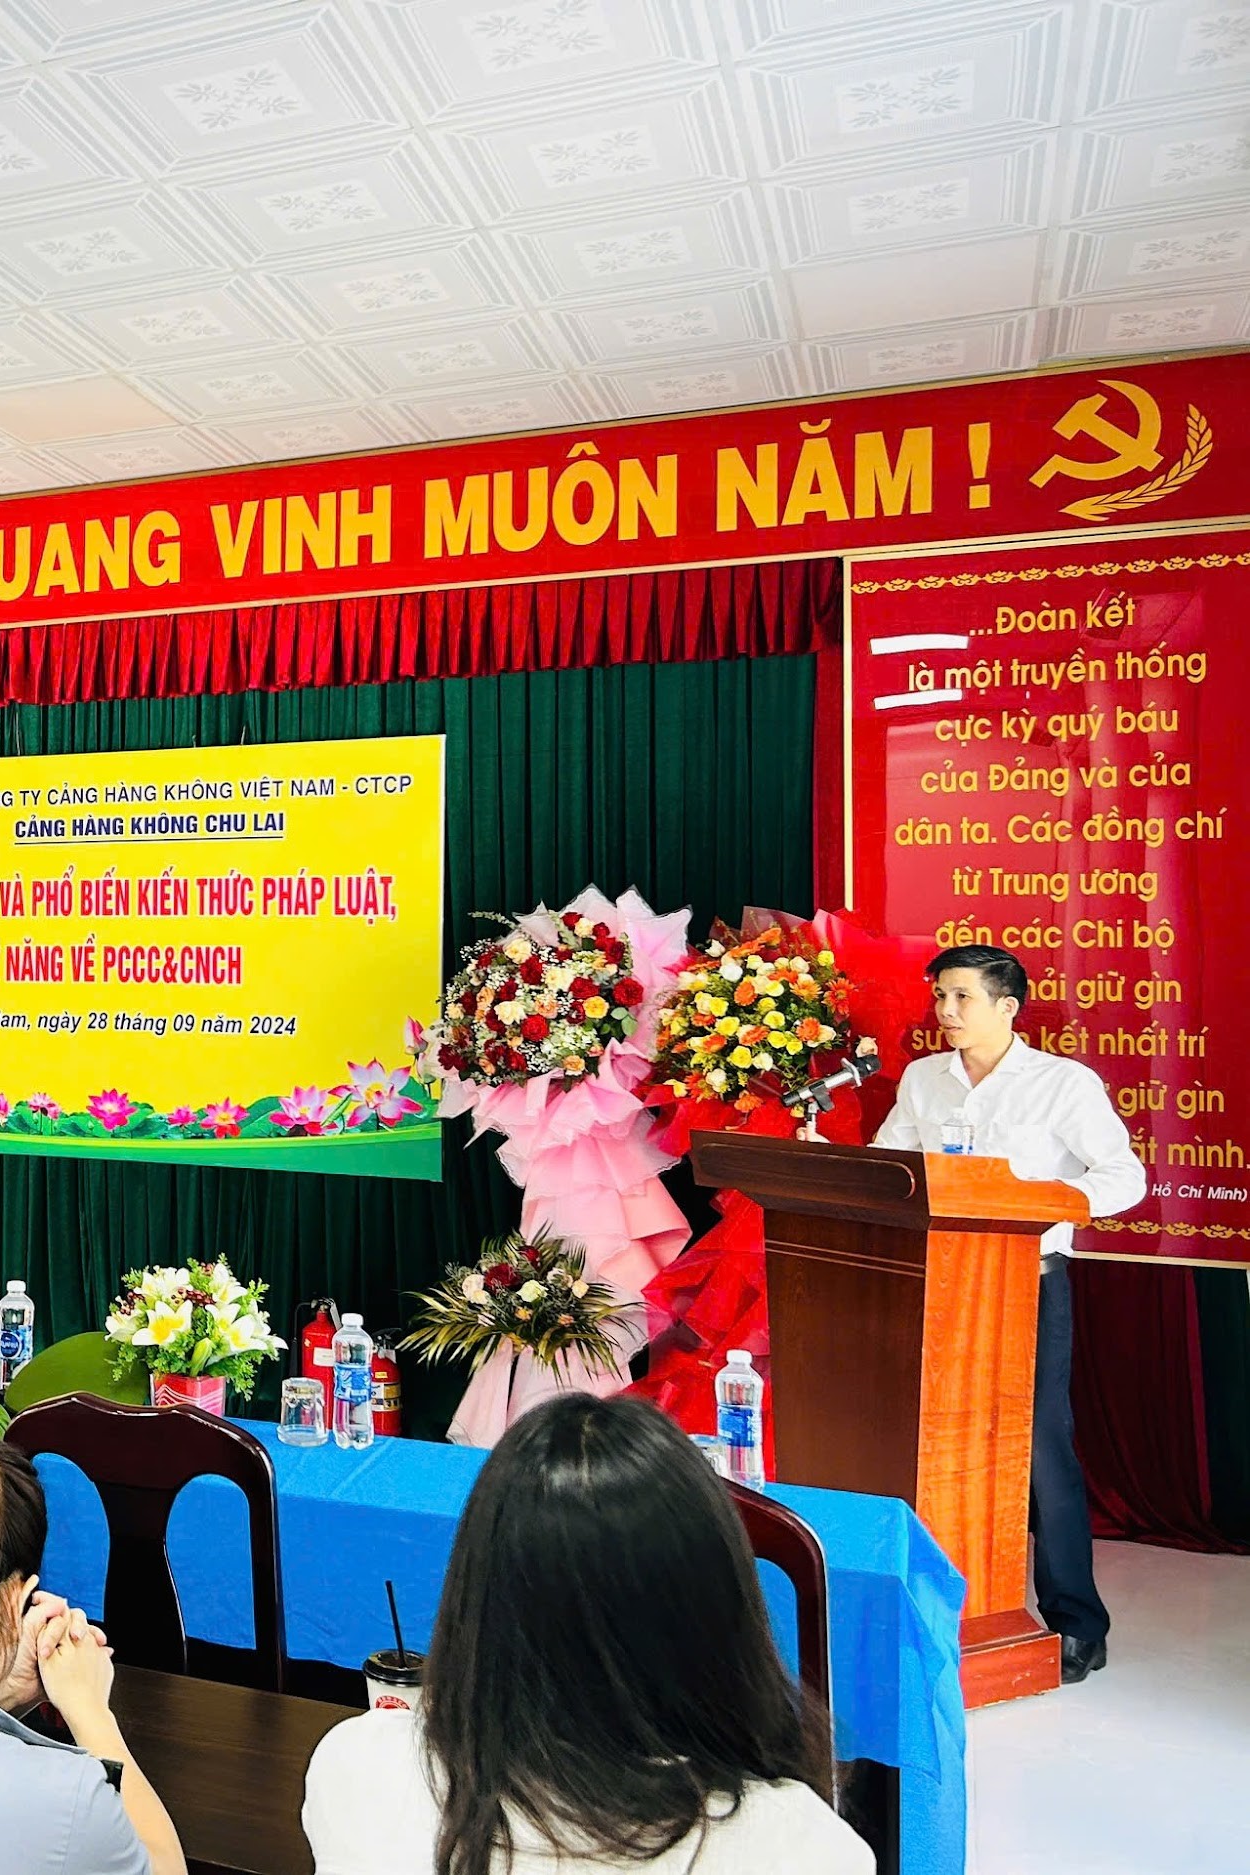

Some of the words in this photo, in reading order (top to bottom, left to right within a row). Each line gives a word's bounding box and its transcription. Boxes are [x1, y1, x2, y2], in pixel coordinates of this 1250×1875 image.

[211, 485, 391, 578] VINH
[422, 440, 677, 558] MUÔN
[717, 419, 932, 531] NĂM
[969, 423, 990, 508] !
[1087, 592, 1135, 628] kết
[909, 662, 934, 692] là
[945, 660, 1002, 695] một
[1011, 648, 1105, 690] truyền
[1116, 643, 1206, 683] thống
[934, 717, 991, 747] cực
[1002, 709, 1036, 743] kỳ
[1048, 704, 1105, 742] quý
[1117, 701, 1177, 733] báu
[20, 790, 40, 805] TY
[48, 783, 97, 804] CẢNG
[106, 782, 156, 802] HÀNG
[165, 780, 232, 800] KHÔNG
[241, 777, 283, 800] VIỆT
[291, 779, 333, 796] NAM
[356, 776, 411, 794] CTCP
[918, 758, 979, 794] của
[988, 757, 1072, 796] Đảng
[1080, 759, 1117, 788] và
[1129, 752, 1190, 786] của
[16, 815, 65, 837] CẢNG
[73, 815, 123, 836] HÀNG
[131, 813, 197, 834] KHÔNG
[206, 814, 245, 832] CHU
[254, 813, 283, 831] LAI
[895, 817, 952, 845] dân
[960, 820, 997, 844] ta.
[1008, 812, 1072, 843] Các
[1083, 806, 1164, 848] đồng
[1176, 808, 1227, 839] chí
[0, 873, 25, 917] VÀ
[32, 865, 74, 918] PHỔ
[80, 866, 129, 917] BIẾN
[138, 866, 189, 917] KIẾN
[196, 871, 253, 916] THỨC
[262, 866, 324, 916] PHÁP
[334, 868, 397, 925] LUẬT,
[953, 866, 982, 895] từ
[989, 868, 1070, 902] Trung
[1080, 869, 1158, 900] ương
[936, 914, 992, 949] đến
[1002, 918, 1062, 948] các
[1072, 919, 1122, 948] Chi
[1134, 918, 1174, 955] bộ
[6, 939, 63, 982] NĂNG
[71, 934, 96, 982] VỀ
[102, 945, 242, 985] PCCC&CNCH
[1076, 971, 1125, 1008] giữ
[1135, 971, 1181, 1009] gìn
[38, 1012, 81, 1033] ngày
[88, 1013, 107, 1029] 28
[115, 1013, 166, 1035] tháng
[174, 1015, 194, 1031] 09
[202, 1016, 242, 1033] năm
[250, 1017, 295, 1034] 2024
[1038, 1022, 1088, 1054] kết
[1100, 1020, 1168, 1056] nhất
[1178, 1027, 1208, 1056] trí
[1118, 1081, 1167, 1116] giữ
[1177, 1081, 1223, 1119] gìn
[1129, 1135, 1157, 1163] ắt
[1169, 1136, 1250, 1169] mình.
[1152, 1182, 1172, 1198] Hồ
[1178, 1183, 1202, 1199] Chí
[1207, 1184, 1247, 1202] Minh)
